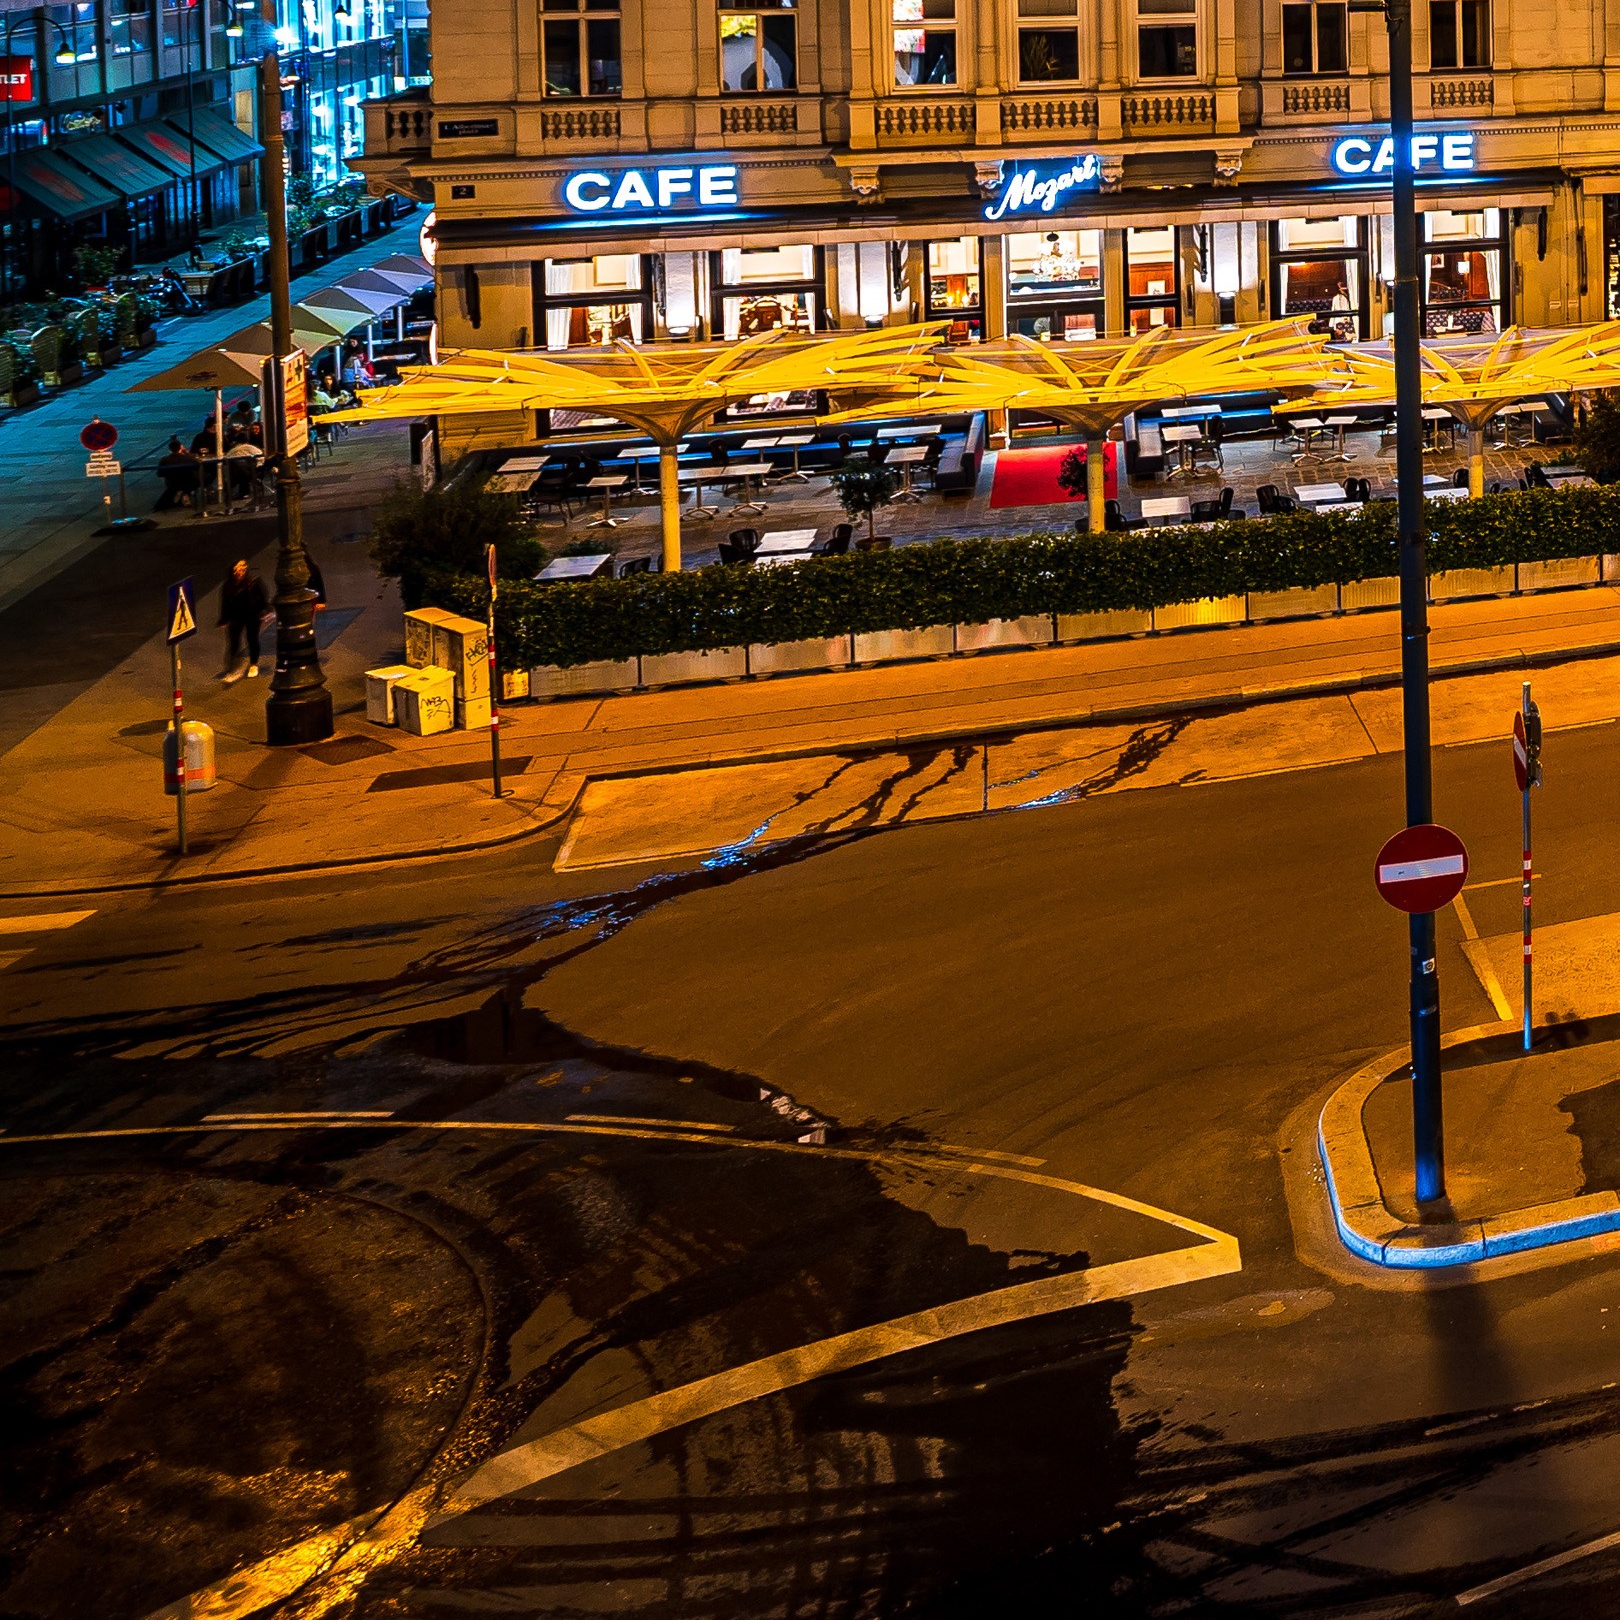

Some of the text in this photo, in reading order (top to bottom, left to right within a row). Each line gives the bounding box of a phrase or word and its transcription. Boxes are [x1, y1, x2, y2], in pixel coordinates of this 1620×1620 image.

[1335, 135, 1474, 173] CAFE
[566, 167, 738, 210] CAFE
[985, 155, 1097, 219] Mozart
